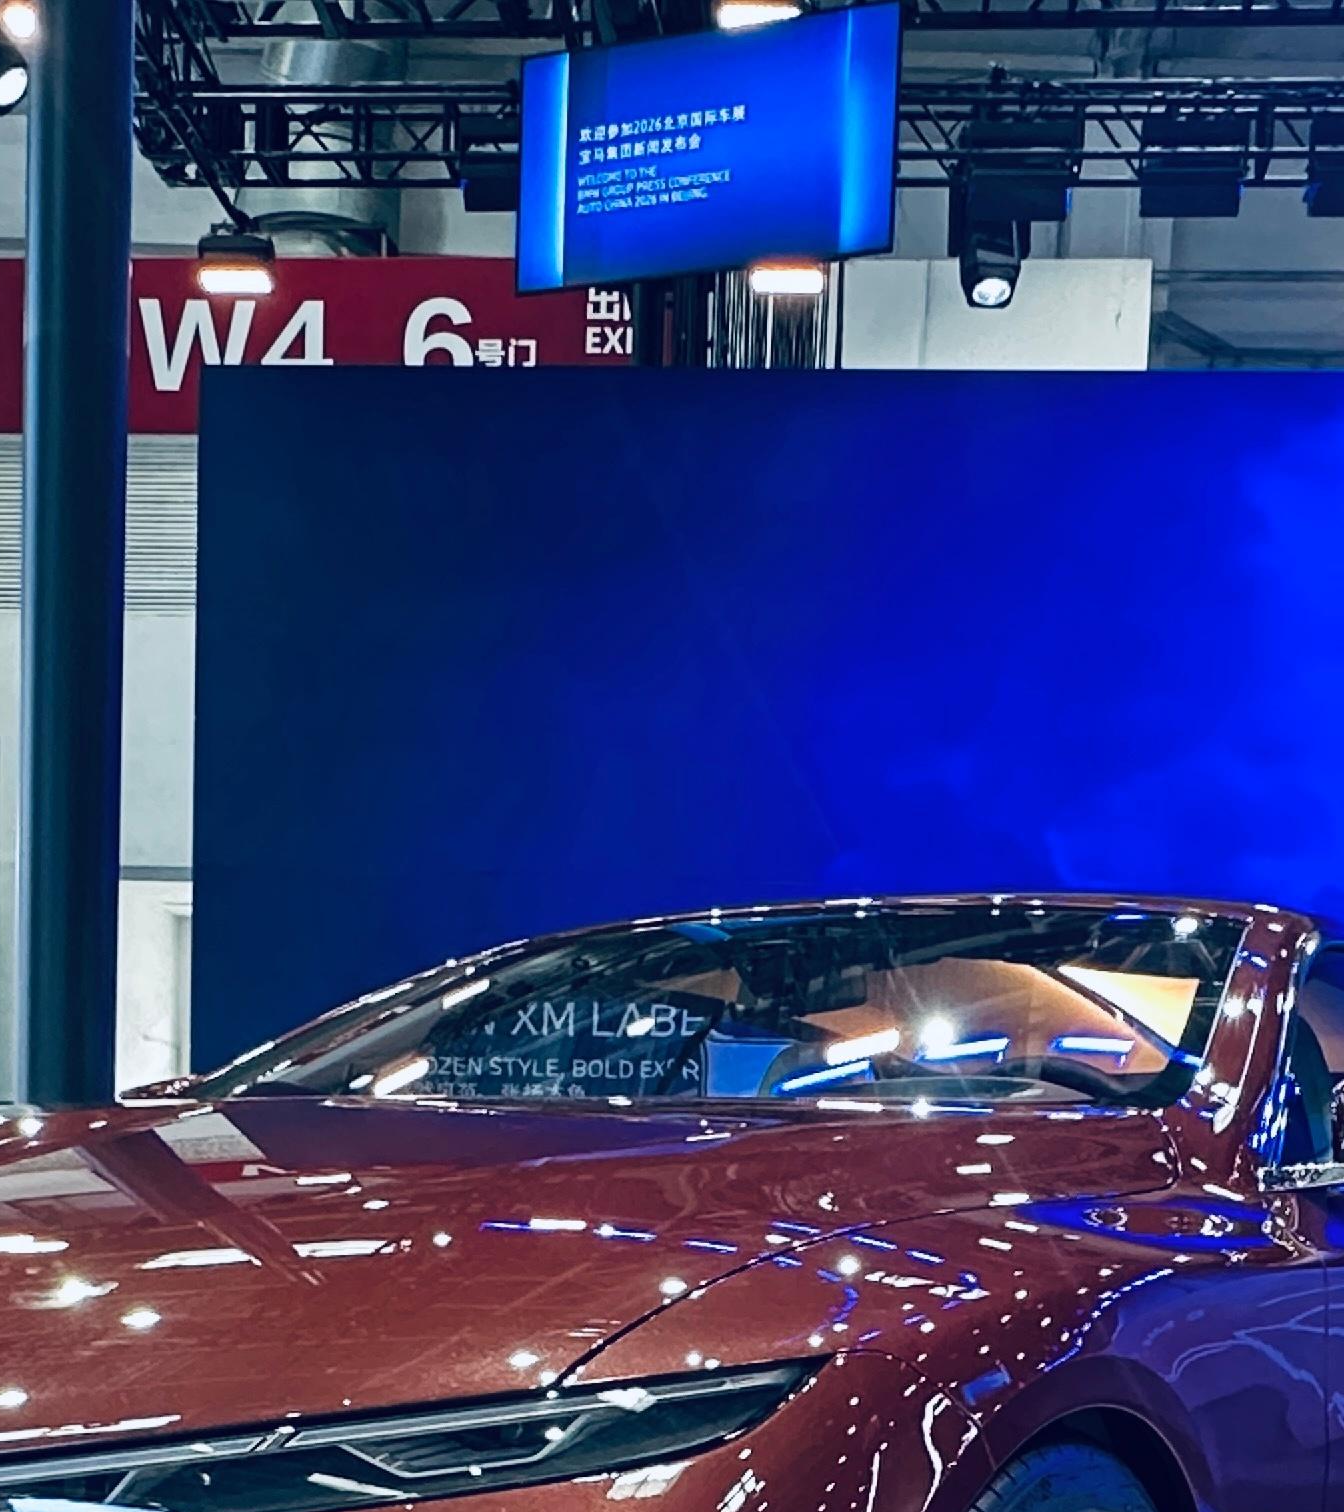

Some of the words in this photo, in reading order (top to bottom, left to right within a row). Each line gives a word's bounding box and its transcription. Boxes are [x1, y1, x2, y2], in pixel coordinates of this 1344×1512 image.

[138, 297, 334, 392] W4
[510, 1001, 575, 1036] XM
[571, 1058, 634, 1079] BOLD
